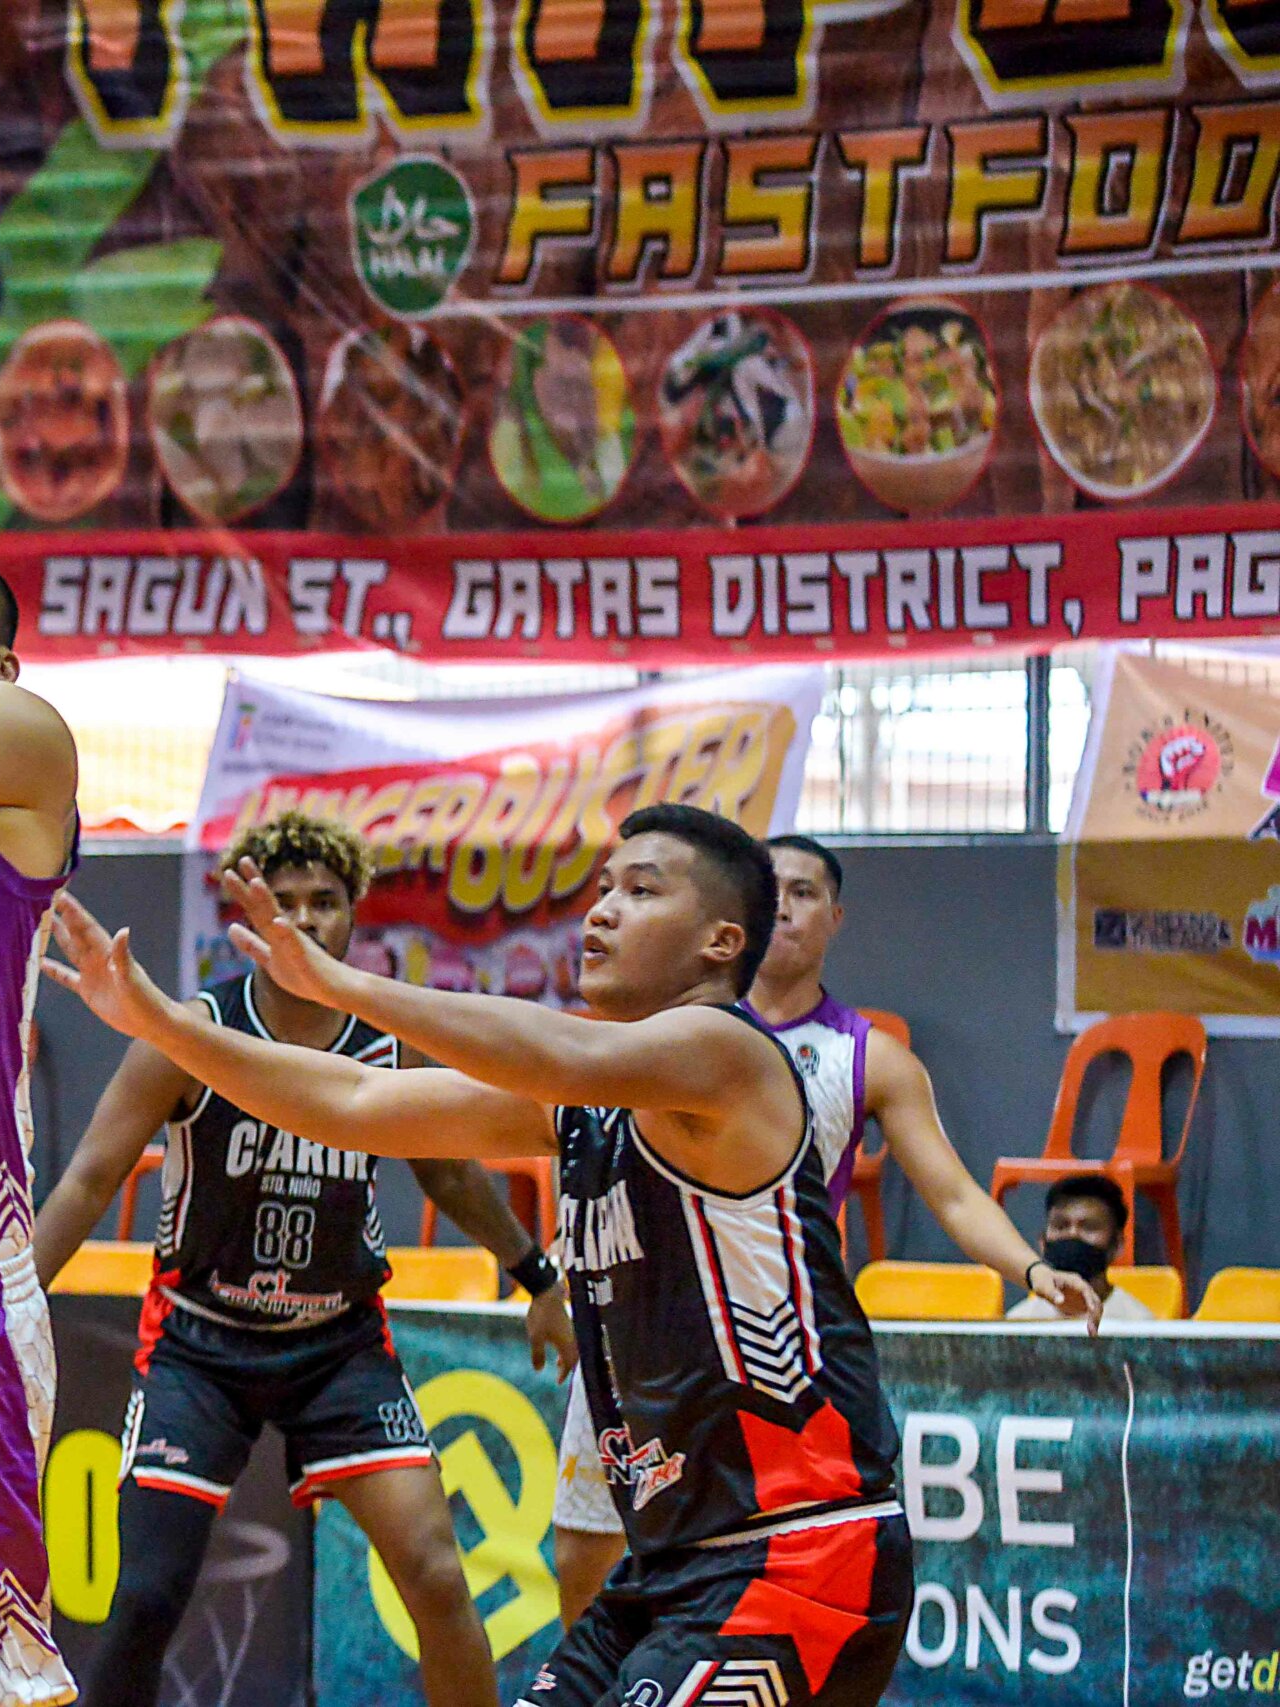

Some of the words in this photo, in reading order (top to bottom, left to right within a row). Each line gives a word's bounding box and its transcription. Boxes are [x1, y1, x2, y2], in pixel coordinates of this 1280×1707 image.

[38, 555, 269, 637] SAGUN
[442, 555, 682, 641] GATAS
[709, 541, 1084, 640] DISTRICT,
[254, 1201, 316, 1270] 88
